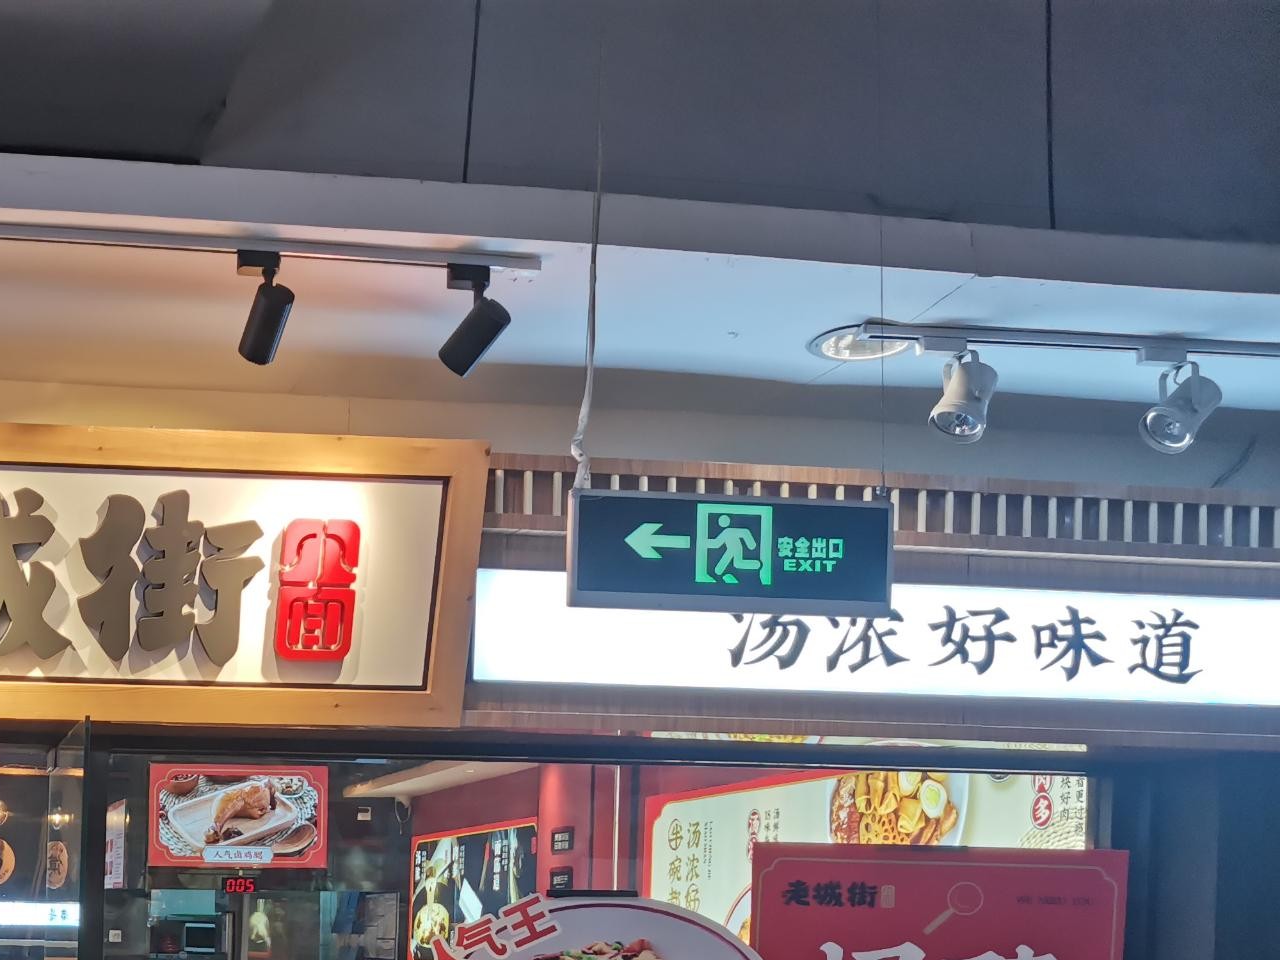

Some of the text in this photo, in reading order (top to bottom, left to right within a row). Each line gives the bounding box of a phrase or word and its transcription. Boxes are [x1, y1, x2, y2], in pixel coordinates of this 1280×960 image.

[777, 536, 844, 559] 安全出口
[783, 559, 837, 572] EXIT
[726, 604, 1205, 684] 汤浓好味道
[226, 879, 255, 893] 005
[782, 879, 878, 909] 老城街
